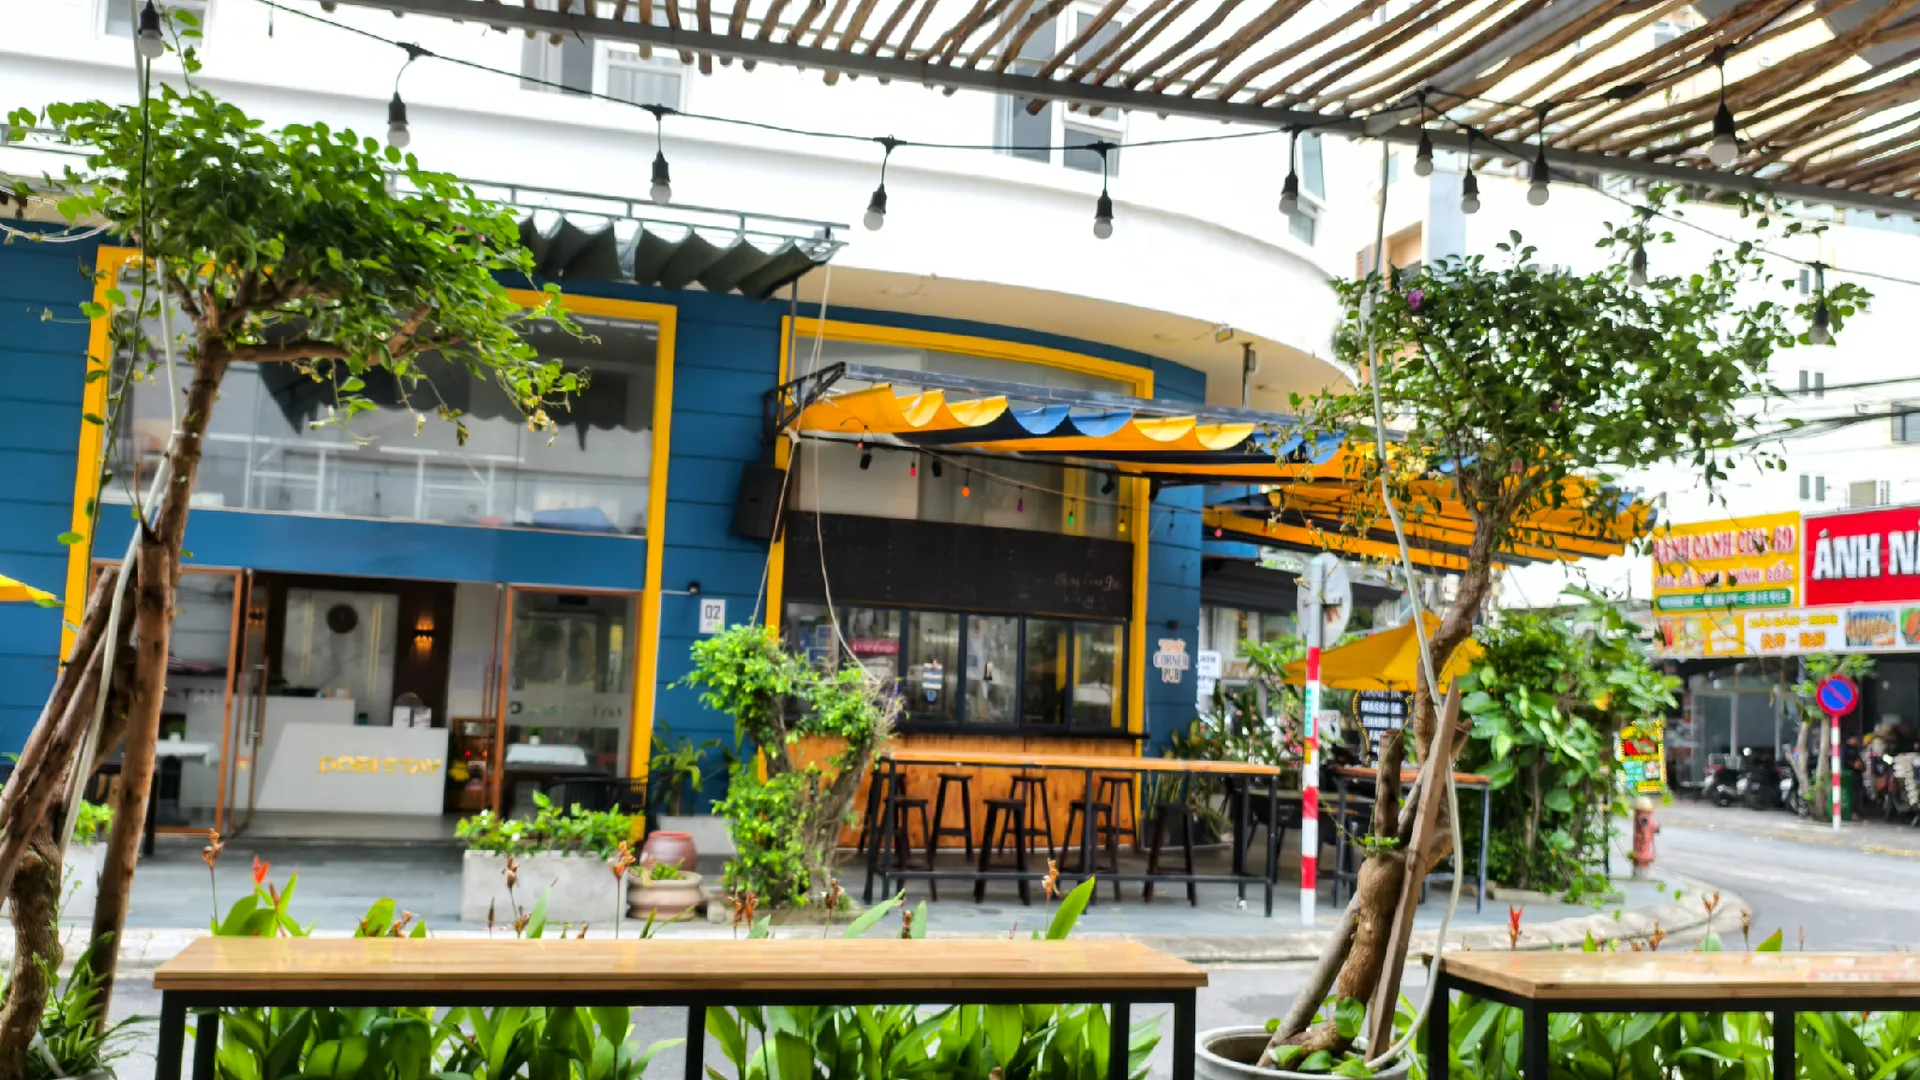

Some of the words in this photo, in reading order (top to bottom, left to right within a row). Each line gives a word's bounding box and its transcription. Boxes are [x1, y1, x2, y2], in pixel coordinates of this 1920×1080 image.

[1812, 528, 1881, 580] ÁNH
[705, 605, 721, 619] 02
[1155, 653, 1188, 668] CORNER
[1163, 667, 1179, 681] PUB
[382, 757, 442, 775] STAY
